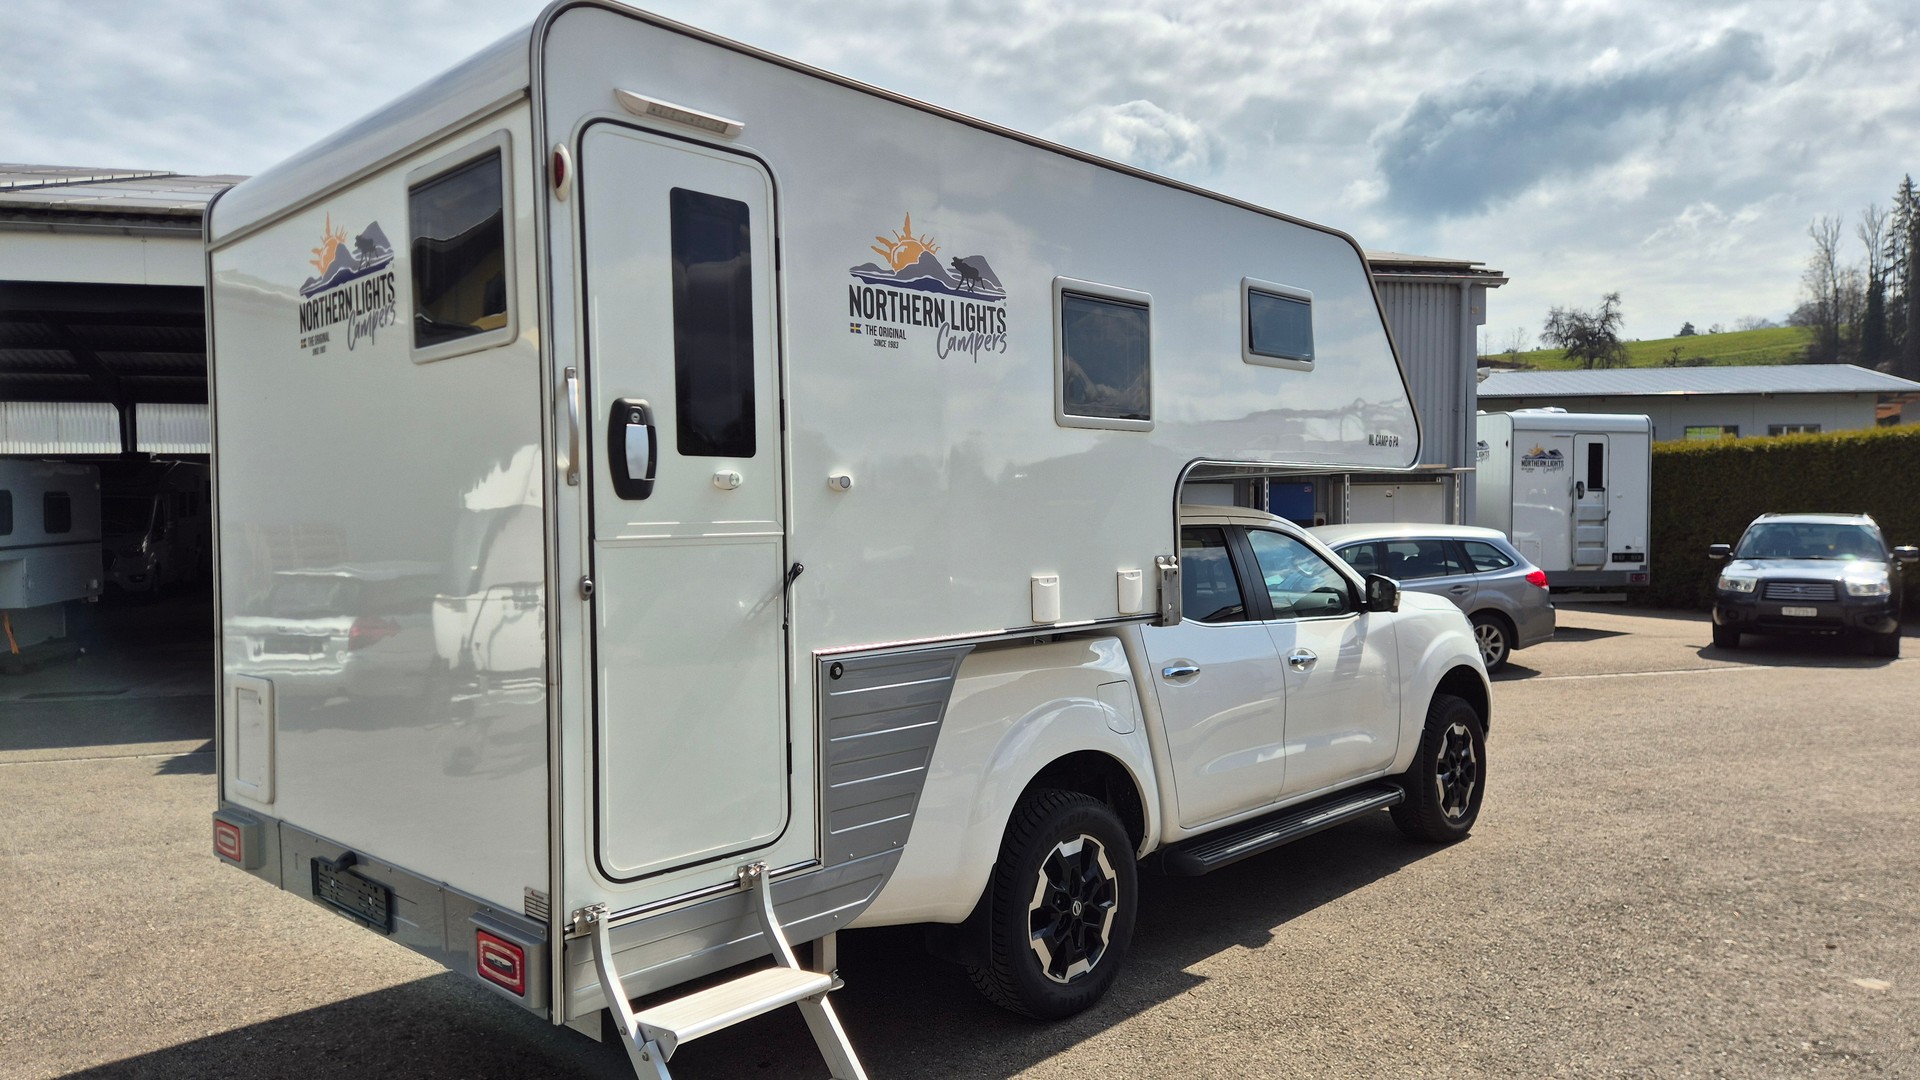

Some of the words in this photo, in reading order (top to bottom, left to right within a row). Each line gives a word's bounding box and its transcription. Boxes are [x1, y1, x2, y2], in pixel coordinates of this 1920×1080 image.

[299, 285, 353, 333] NORTHERN
[355, 272, 395, 316] LIGHTS
[849, 284, 945, 328] NORTHERN
[951, 300, 1007, 334] LIGHTS
[347, 300, 396, 351] Campers
[865, 324, 878, 336] THE
[879, 326, 907, 340] ORIGINAL
[874, 339, 887, 348] SINCE
[936, 321, 1007, 363] Campers
[1375, 435, 1388, 446] CAMP
[1547, 460, 1564, 468] LIGHTS
